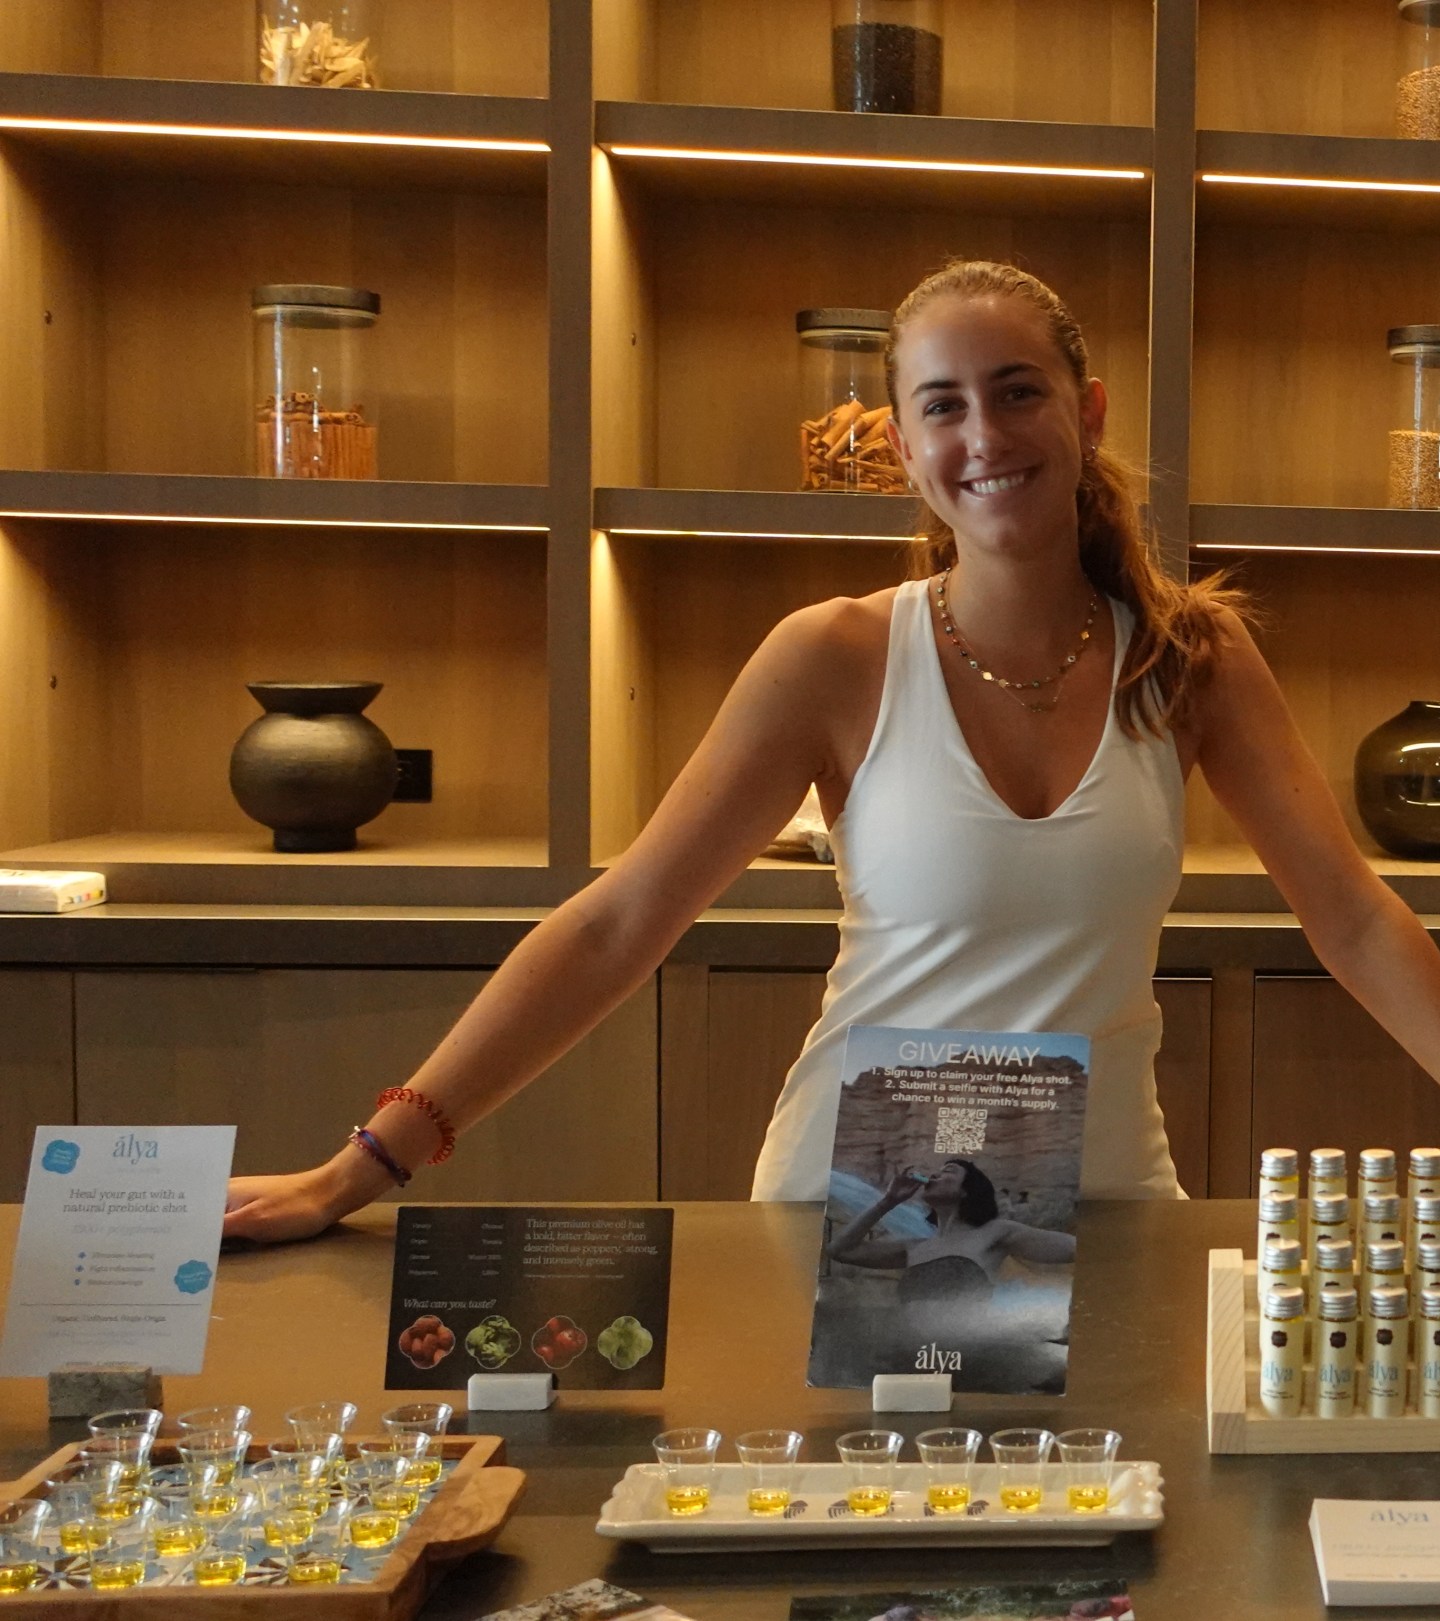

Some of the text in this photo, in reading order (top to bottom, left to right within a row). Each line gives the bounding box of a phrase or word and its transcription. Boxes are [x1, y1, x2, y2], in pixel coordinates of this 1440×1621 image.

[900, 1040, 1041, 1067] GIVEAWAY
[884, 1067, 908, 1079] Sign
[910, 1070, 924, 1080] up
[926, 1069, 937, 1079] to
[939, 1069, 968, 1080] claim
[970, 1073, 993, 1083] your
[996, 1072, 1018, 1083] free
[1020, 1073, 1043, 1085] Alya
[1045, 1075, 1073, 1085] shot.
[885, 1079, 895, 1089] 2.
[899, 1080, 937, 1091] Submit
[938, 1083, 946, 1091] a
[949, 1081, 978, 1093] selfie
[979, 1083, 1003, 1094] with
[1005, 1085, 1029, 1096] Alya
[1030, 1086, 1045, 1096] for
[892, 1093, 1060, 1111] chance to win a month's supply.
[112, 1133, 159, 1165] álya
[69, 1188, 97, 1199] Heal
[100, 1191, 125, 1202] your
[128, 1190, 147, 1201] gut
[150, 1189, 175, 1199] with
[63, 1202, 188, 1215] natural prebiotic shot
[526, 1219, 645, 1230] This premium olive oil has
[533, 1231, 555, 1242] bold,
[557, 1232, 582, 1241] bitter
[584, 1231, 610, 1241] flavor
[622, 1232, 646, 1241] often
[523, 1243, 569, 1253] described
[570, 1245, 580, 1253] as
[624, 1244, 658, 1255] strong,
[523, 1256, 615, 1267] and intensely green.
[403, 1299, 497, 1311] What can you taste?
[915, 1341, 962, 1375] álya
